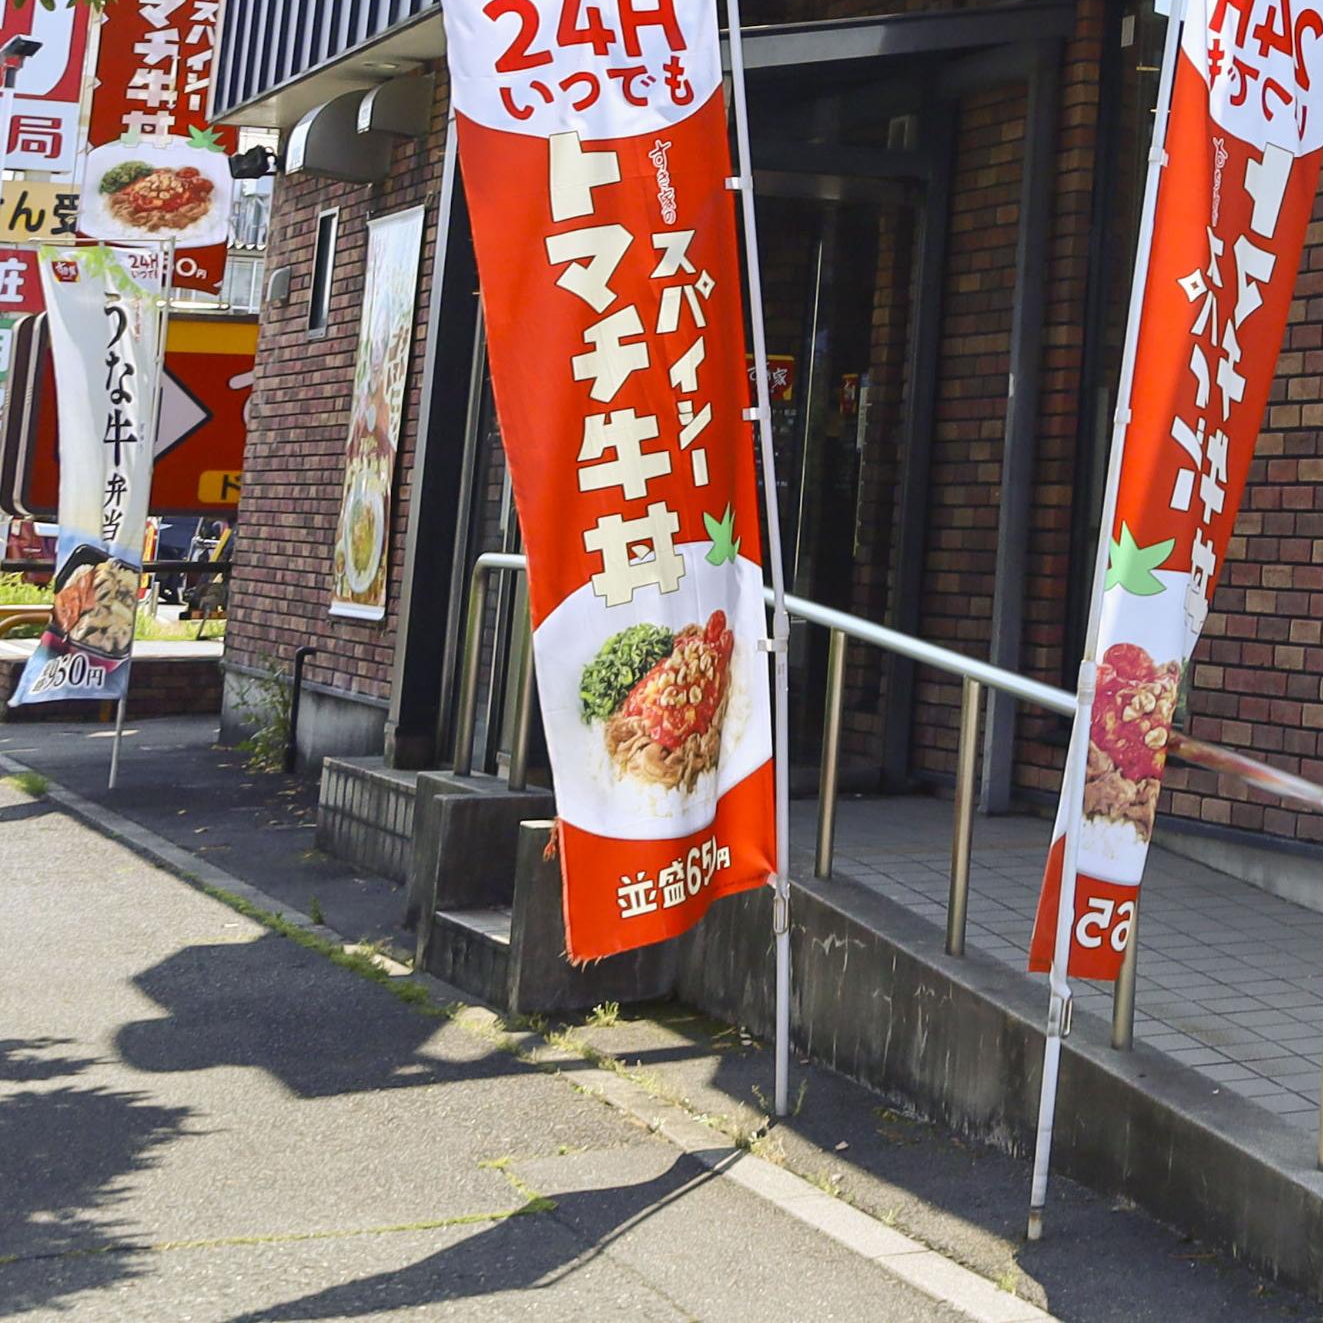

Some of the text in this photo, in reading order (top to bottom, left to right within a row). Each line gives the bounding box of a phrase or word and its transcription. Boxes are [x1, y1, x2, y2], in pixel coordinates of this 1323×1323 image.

[499, 55, 694, 120] いつでも
[6, 114, 63, 159] 局
[128, 253, 159, 268] 24H
[544, 131, 686, 608] トマチ牛丼
[650, 229, 716, 488] スパイシー
